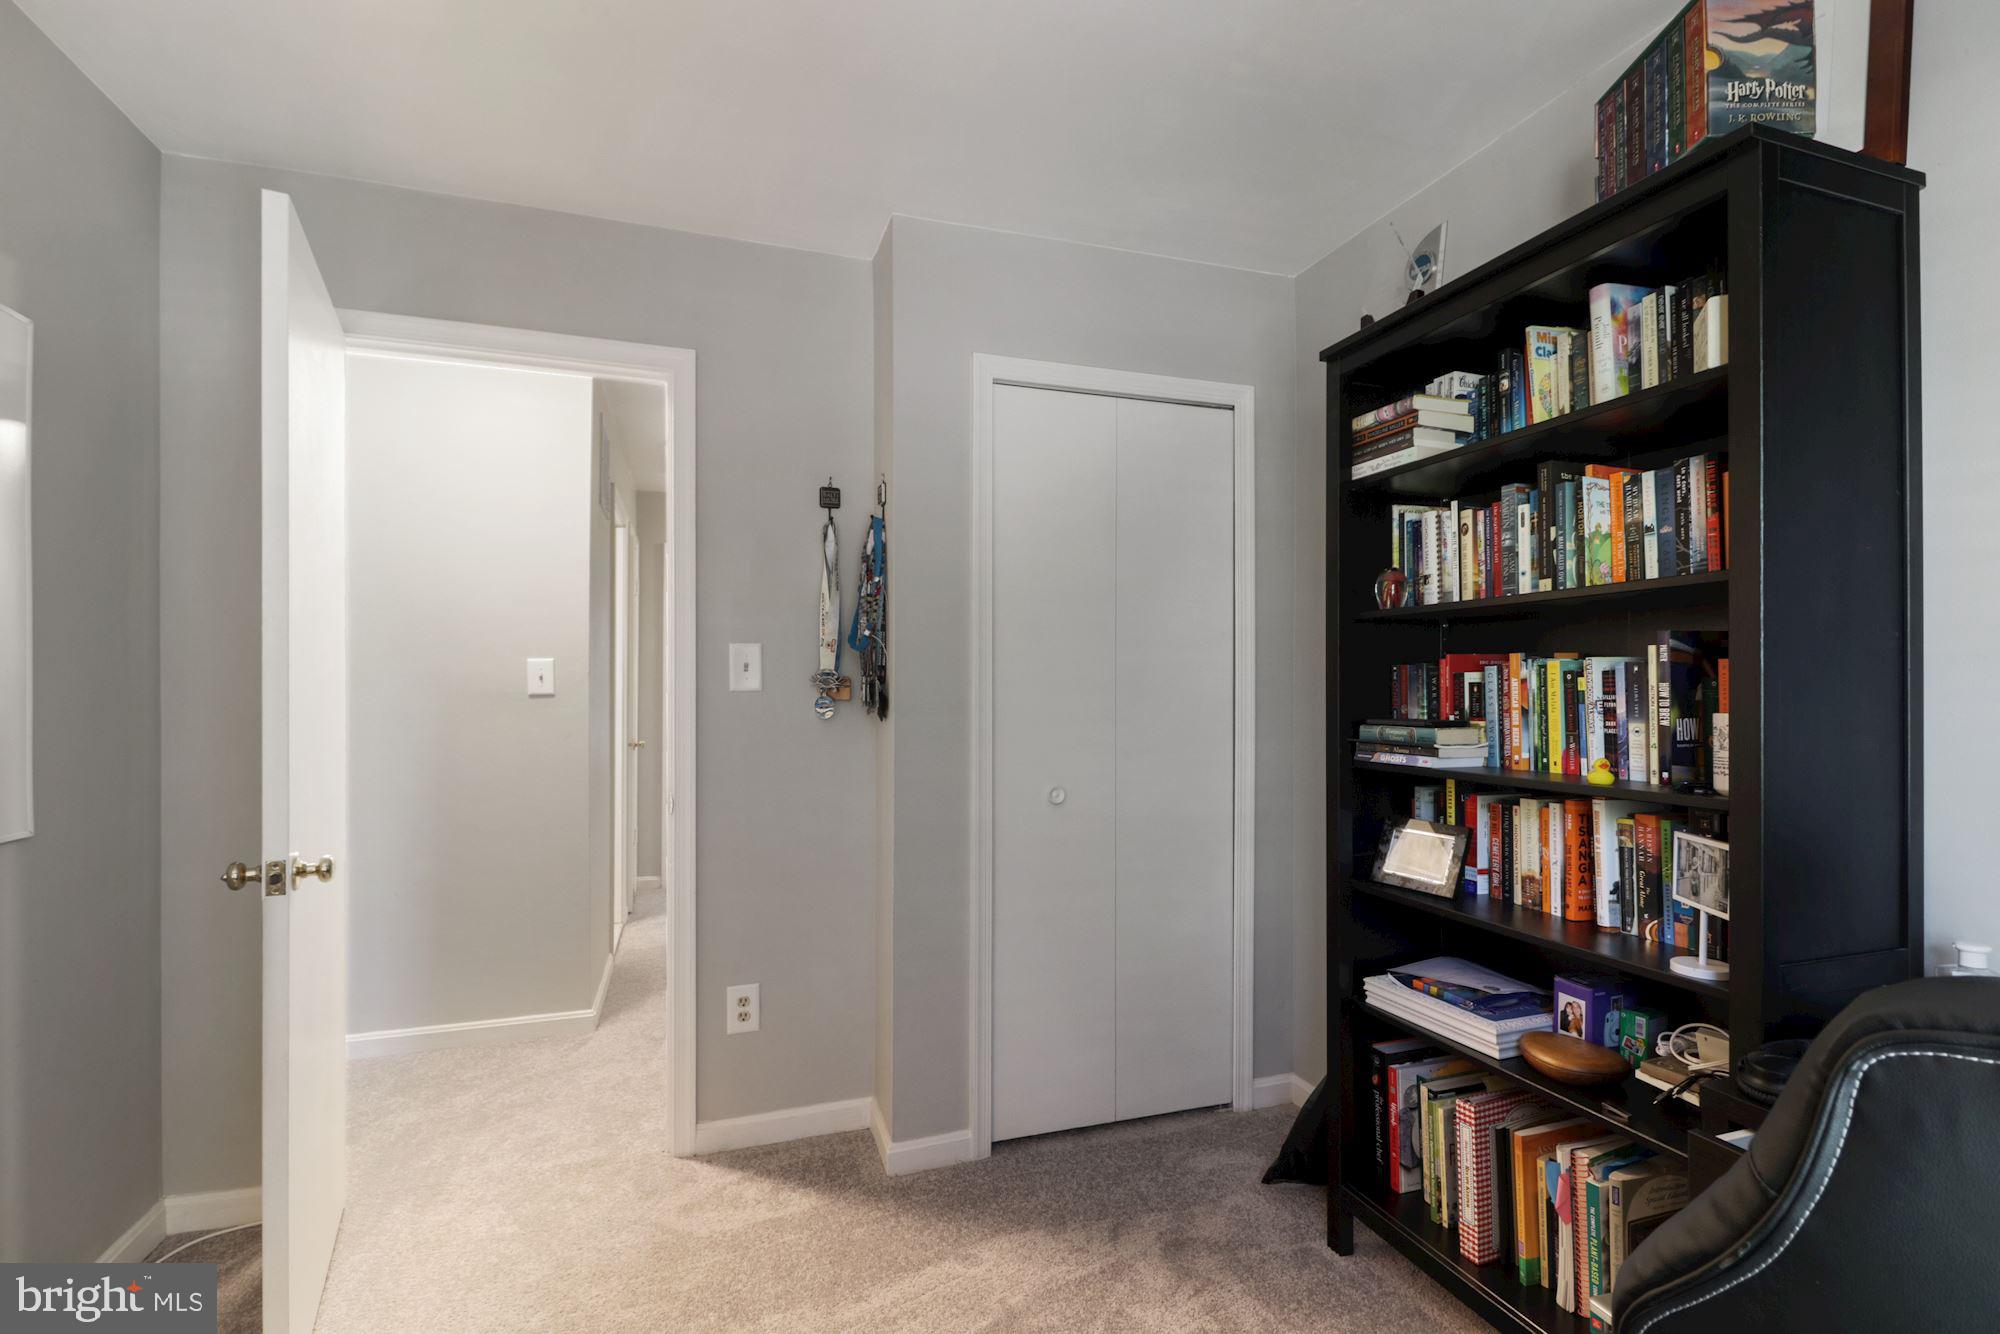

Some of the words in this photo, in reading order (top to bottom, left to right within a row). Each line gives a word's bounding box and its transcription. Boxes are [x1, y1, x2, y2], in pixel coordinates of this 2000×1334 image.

[1726, 80, 1765, 102] Harry
[1764, 77, 1807, 100] Potter
[1749, 111, 1802, 122] ROWLING
[1625, 484, 1633, 523] HAMILTON
[1511, 677, 1519, 708] AMERICAN
[1658, 682, 1670, 698] HOW
[1658, 698, 1670, 706] TO
[1658, 707, 1670, 727] BREW
[1488, 719, 1496, 759] SWORD
[1380, 753, 1407, 763] GHOSTS
[1491, 837, 1500, 871] CEMETERY
[1637, 825, 1645, 862] HANNAH
[1645, 827, 1653, 864] KRISTIN
[1492, 872, 1500, 888] GIRL
[1638, 870, 1646, 890] Great
[1373, 1089, 1383, 1142] professional
[1376, 1142, 1384, 1163] chef
[1590, 1237, 1599, 1286] PLANT-BASED
